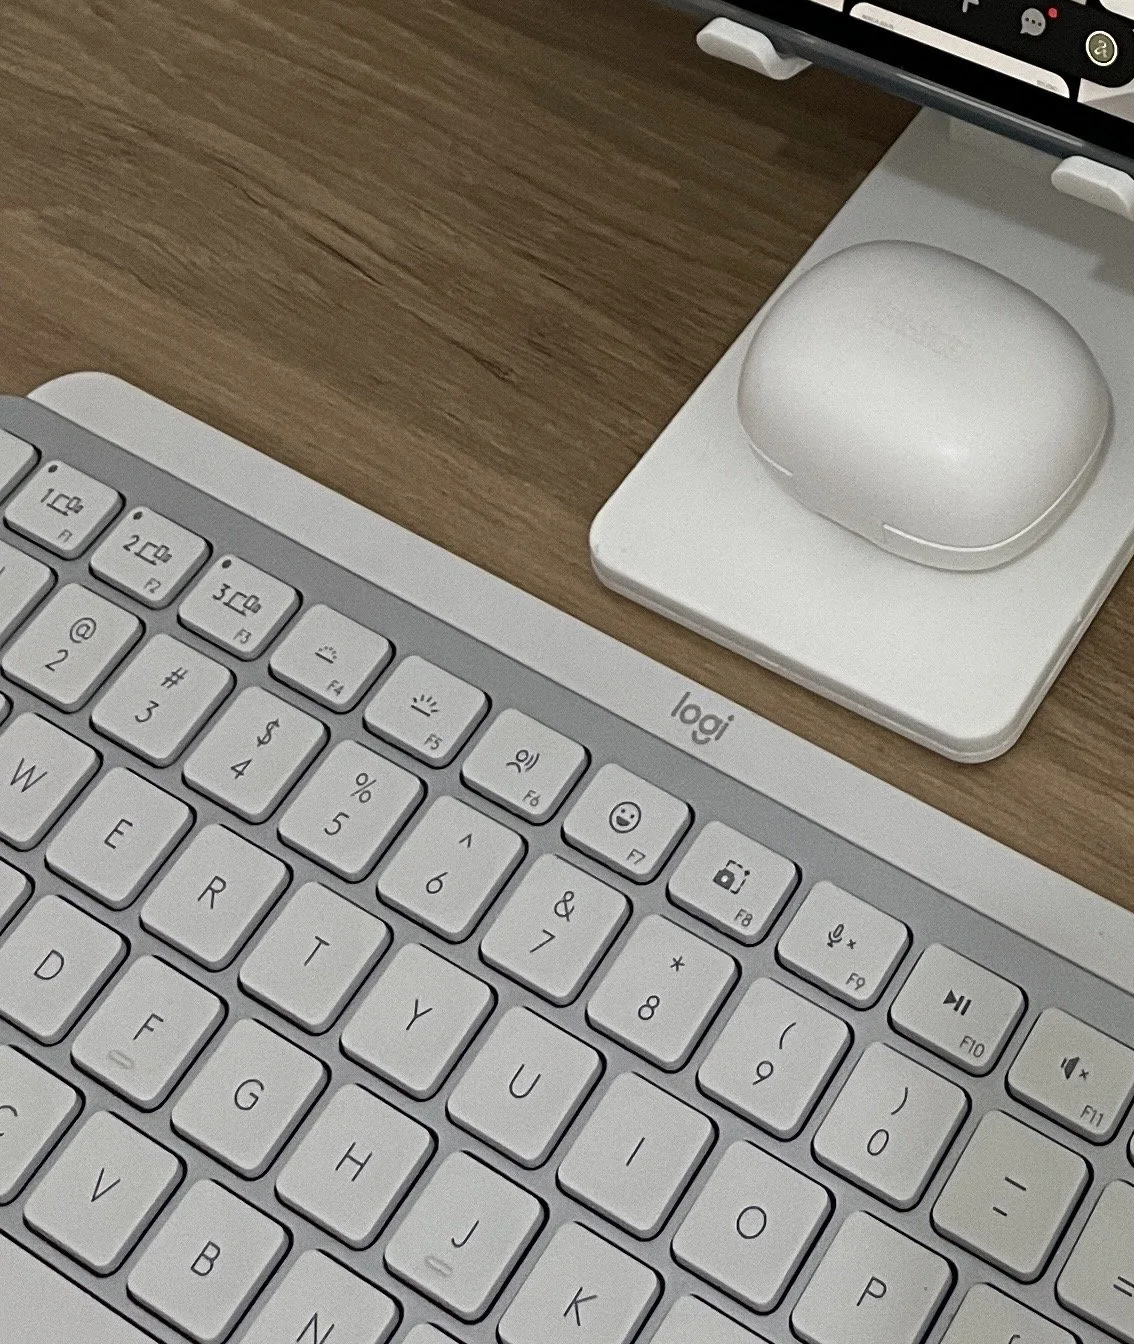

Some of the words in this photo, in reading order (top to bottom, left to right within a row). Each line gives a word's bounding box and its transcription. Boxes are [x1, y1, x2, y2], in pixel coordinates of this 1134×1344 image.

[122, 534, 141, 553] 2
[143, 577, 162, 594] F2
[211, 582, 230, 602] 3
[68, 616, 98, 645] @
[233, 628, 252, 645] F3
[44, 648, 69, 673] 2
[160, 666, 189, 690] #
[326, 679, 345, 697] F4
[134, 699, 160, 724] 3
[670, 691, 735, 745] logi
[256, 718, 280, 748] $
[423, 733, 443, 751] F5
[9, 757, 49, 793] W
[229, 758, 253, 780] 4
[351, 772, 377, 804] %
[522, 789, 541, 808] F6
[103, 818, 134, 850] E
[323, 811, 350, 837] 5
[625, 848, 647, 866] F7
[196, 875, 227, 910] R
[425, 871, 449, 895] 6
[553, 890, 576, 923] &
[733, 908, 754, 928] F8
[303, 935, 331, 967] T
[529, 928, 556, 954] 7
[32, 948, 65, 982] D
[845, 972, 866, 992] F9
[405, 998, 433, 1032] Y
[637, 994, 661, 1022] 8
[132, 1012, 165, 1041] F
[778, 1021, 797, 1051] (
[956, 1034, 986, 1061] F10
[508, 1063, 542, 1100] U
[751, 1060, 775, 1086] 9
[233, 1078, 265, 1112] G
[890, 1086, 909, 1116] )
[1076, 1104, 1105, 1129] F11
[334, 1141, 373, 1183] H
[90, 1167, 122, 1203] V
[450, 1219, 480, 1249] J
[189, 1240, 221, 1278] B
[855, 1275, 888, 1307] P
[562, 1286, 598, 1327] K
